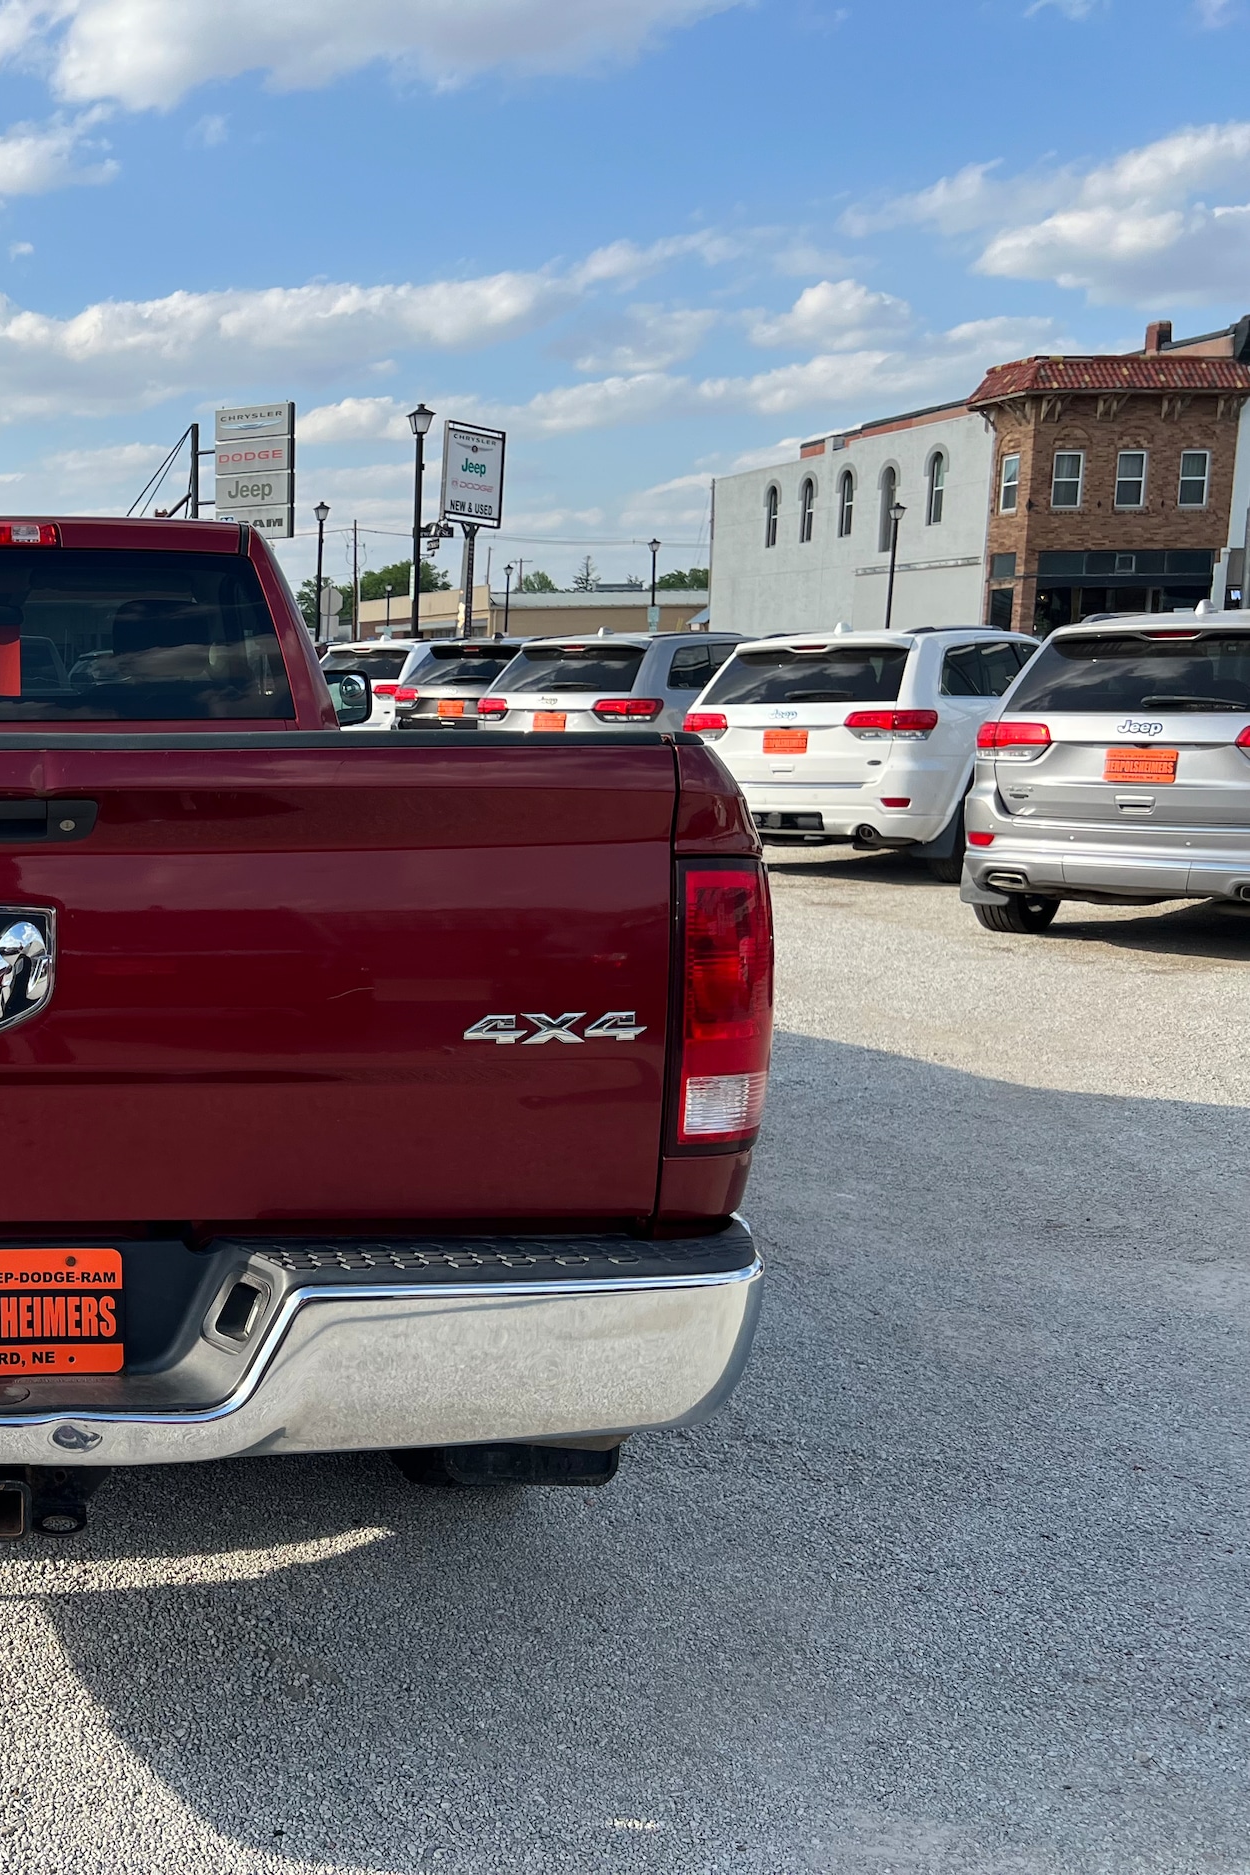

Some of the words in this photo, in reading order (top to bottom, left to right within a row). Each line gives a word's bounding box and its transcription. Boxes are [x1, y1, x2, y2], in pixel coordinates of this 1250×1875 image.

[220, 410, 283, 423] CHRYSLER
[453, 433, 497, 446] CHRYSLER
[218, 449, 283, 464] DODGE
[461, 457, 487, 477] Jeep
[227, 480, 273, 501] Jeep
[459, 481, 494, 493] DODGE
[450, 499, 466, 512] NEW
[467, 502, 473, 513] &
[474, 503, 493, 516] USED
[1117, 720, 1163, 736] Jeep
[31, 1352, 56, 1364] NE
